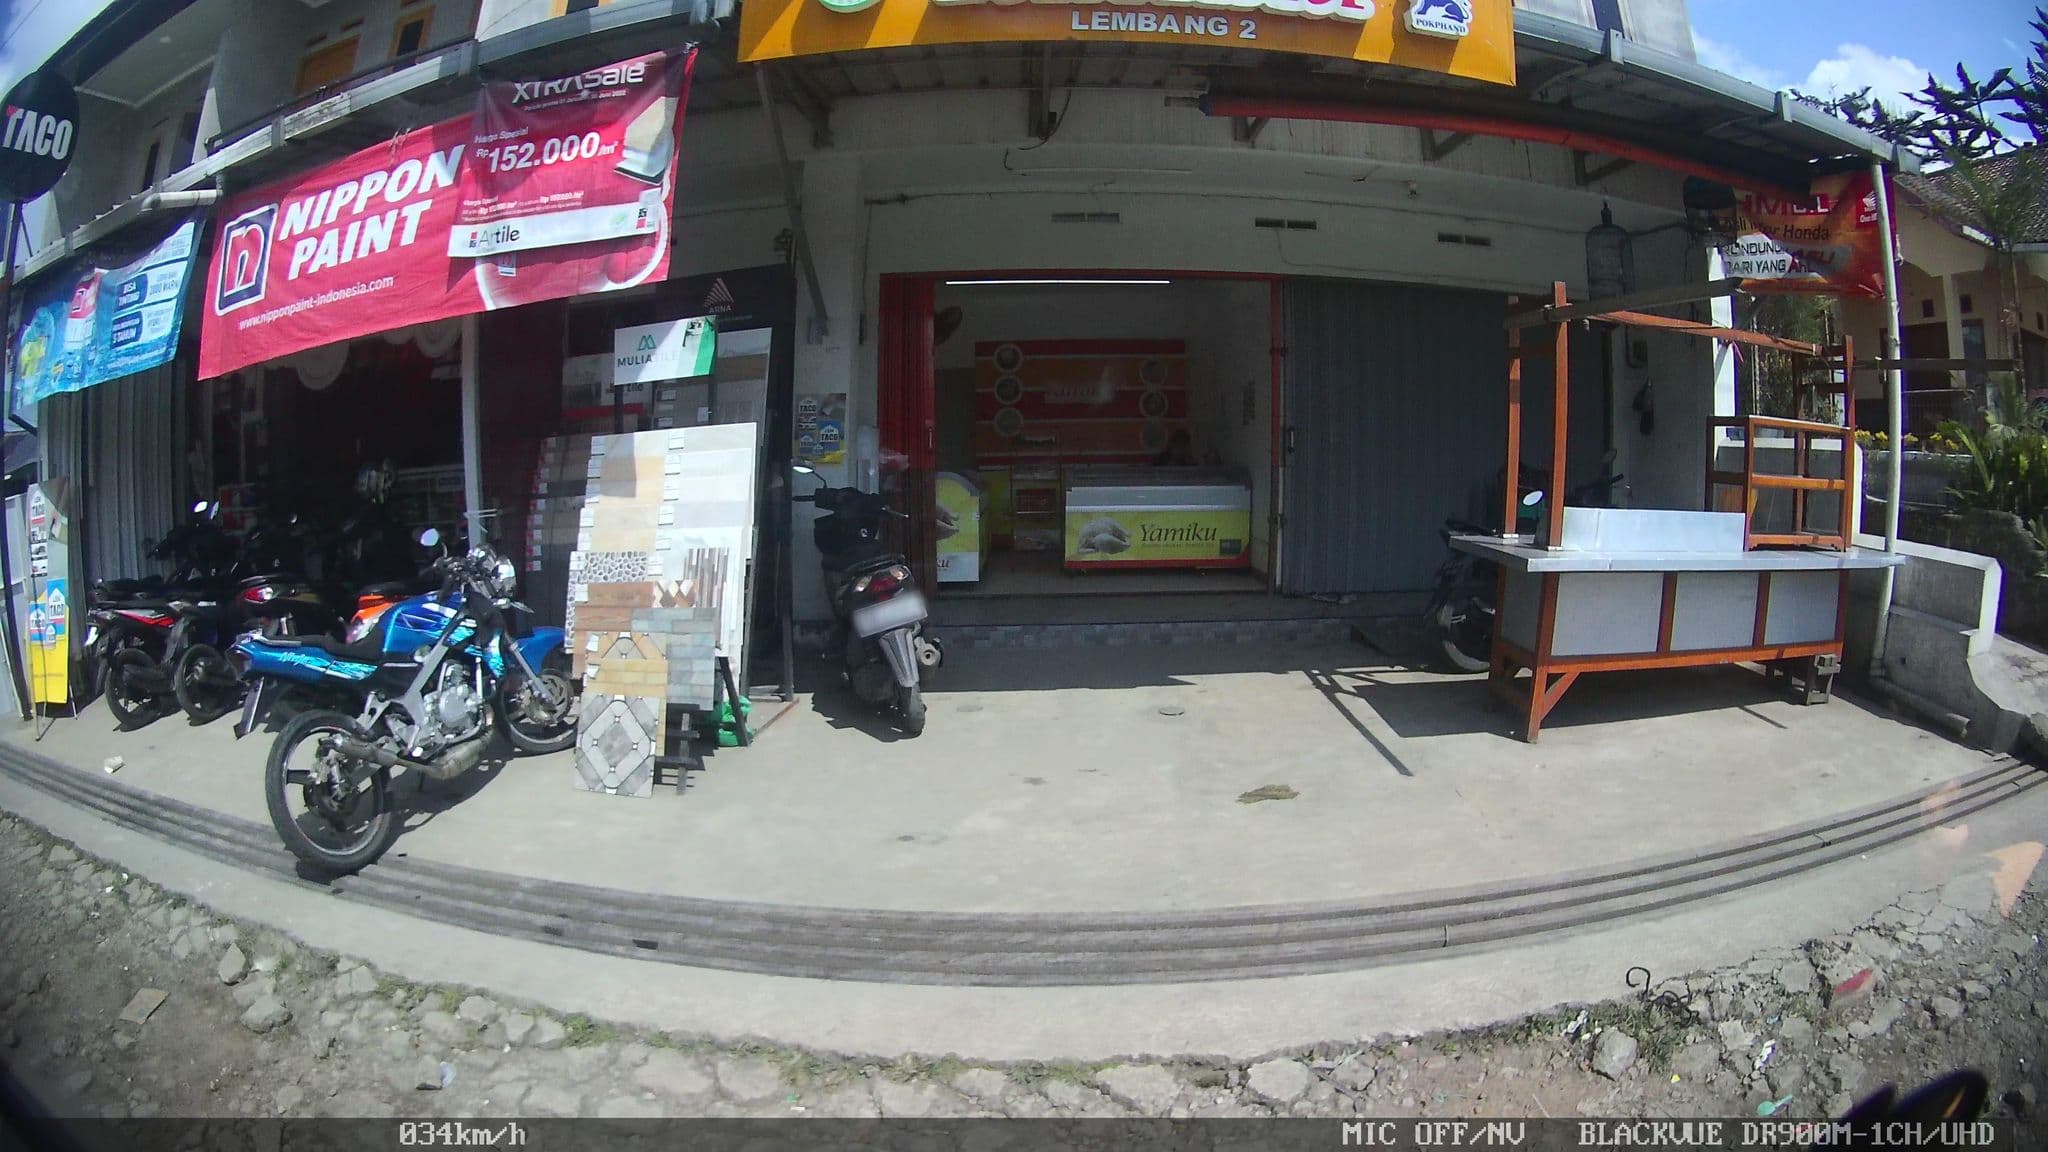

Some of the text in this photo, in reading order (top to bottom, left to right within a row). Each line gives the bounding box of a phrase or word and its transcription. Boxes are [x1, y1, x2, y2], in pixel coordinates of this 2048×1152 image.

[1070, 10, 1257, 40] LEMBANG 2
[1415, 18, 1467, 33] POKPHAND
[2, 106, 74, 160] TACO
[279, 144, 466, 242] NIPPON
[287, 198, 433, 281] PAINT
[478, 224, 520, 247] Artile
[1783, 223, 1829, 241] Honda
[1755, 258, 1787, 274] YANG
[238, 277, 394, 331] www.nipponpaint-indonesia.com
[1138, 521, 1218, 543] Yamiku
